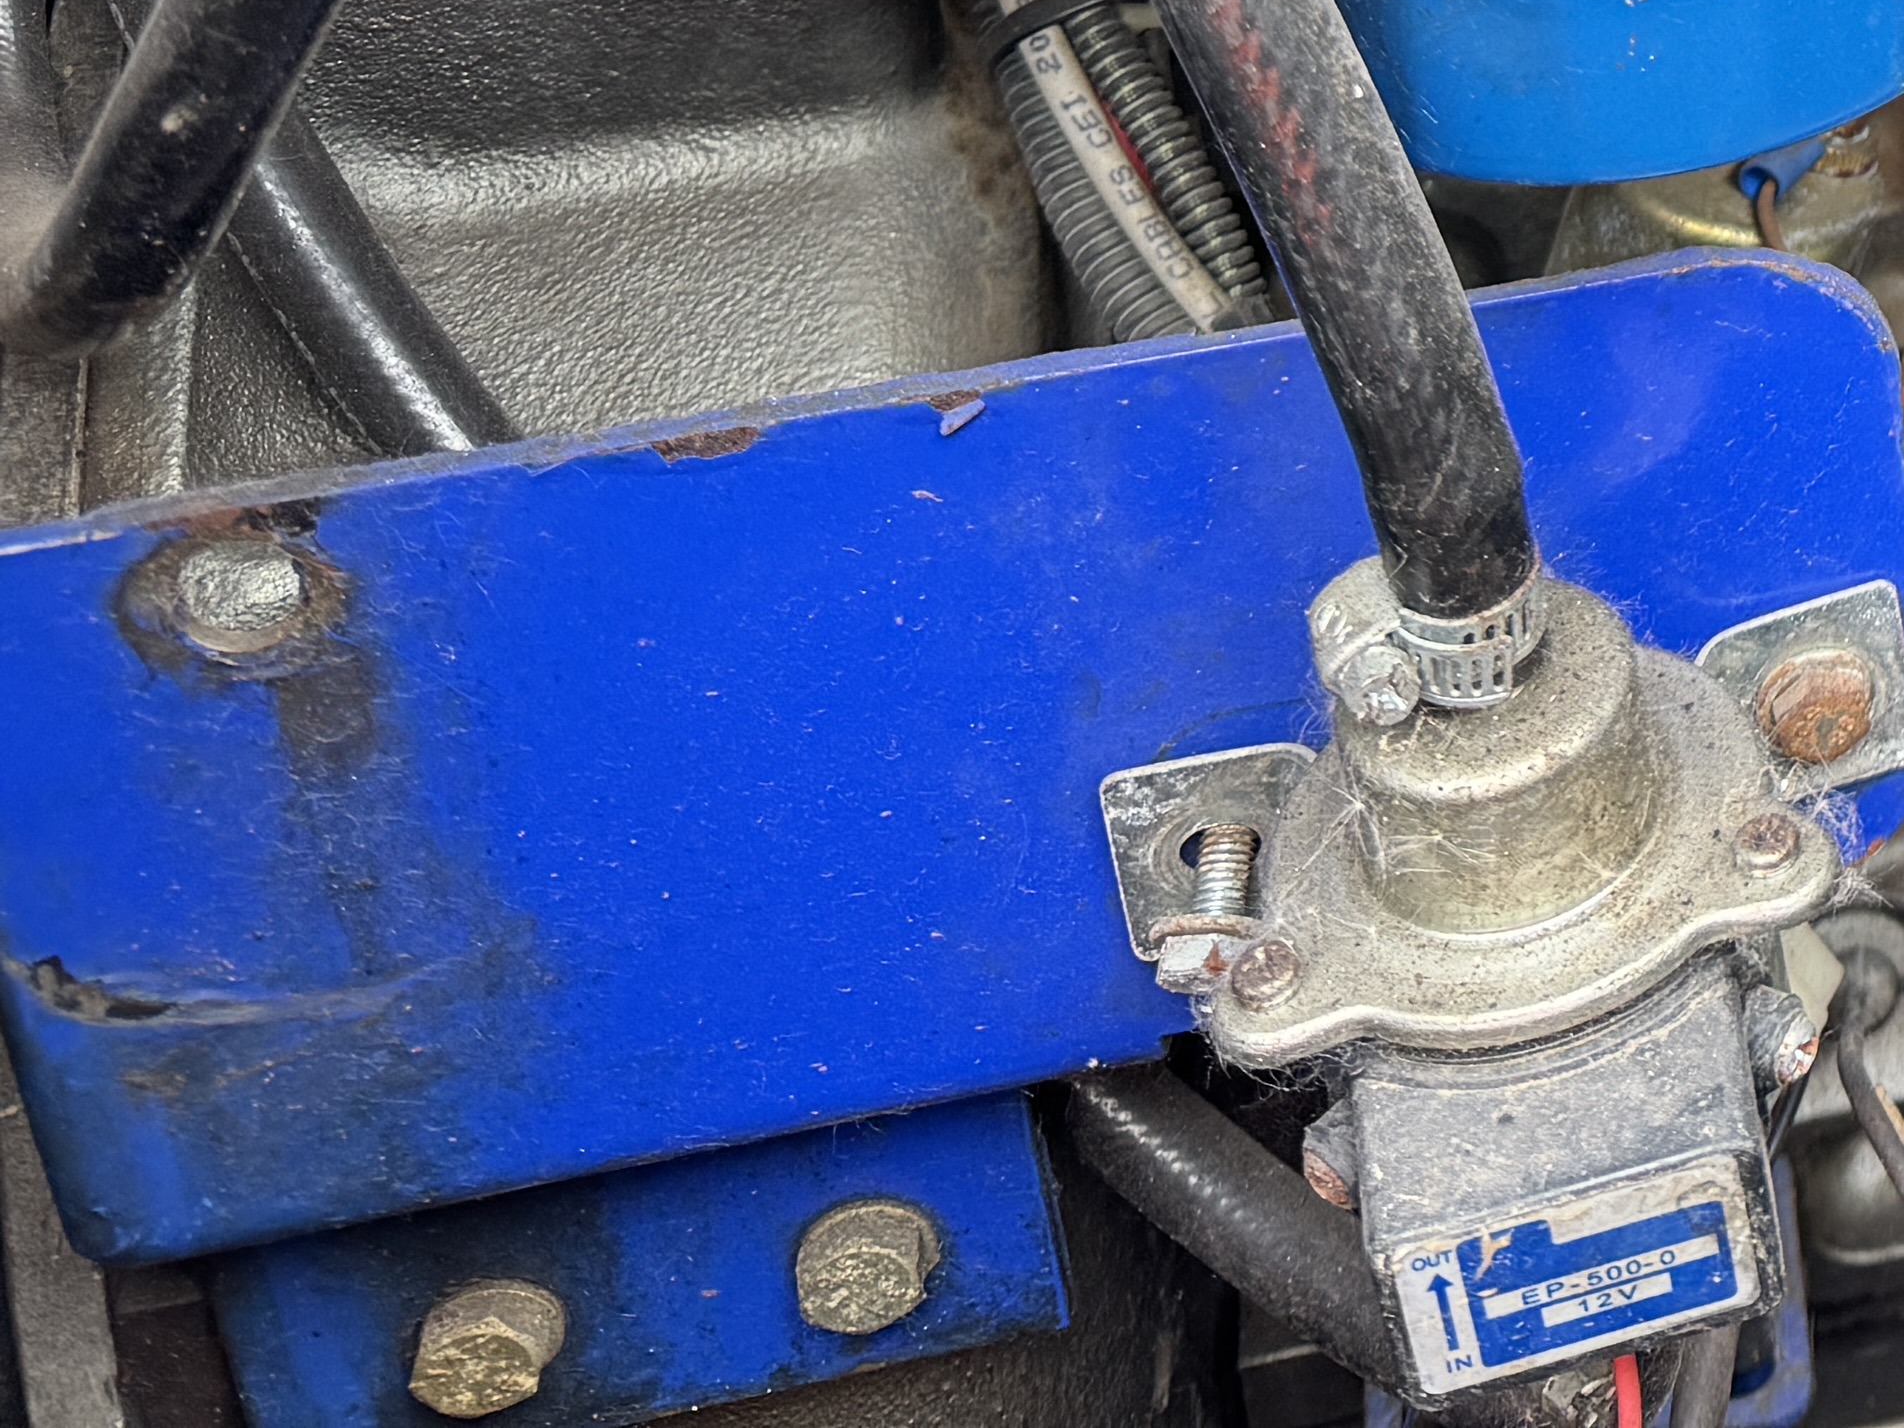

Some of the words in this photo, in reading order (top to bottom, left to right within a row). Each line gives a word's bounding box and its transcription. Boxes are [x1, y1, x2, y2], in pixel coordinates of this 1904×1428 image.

[1060, 94, 1112, 150] CEI
[1411, 1248, 1453, 1272] OUT
[1579, 1284, 1639, 1313] 12V
[1446, 1354, 1474, 1374] IN
